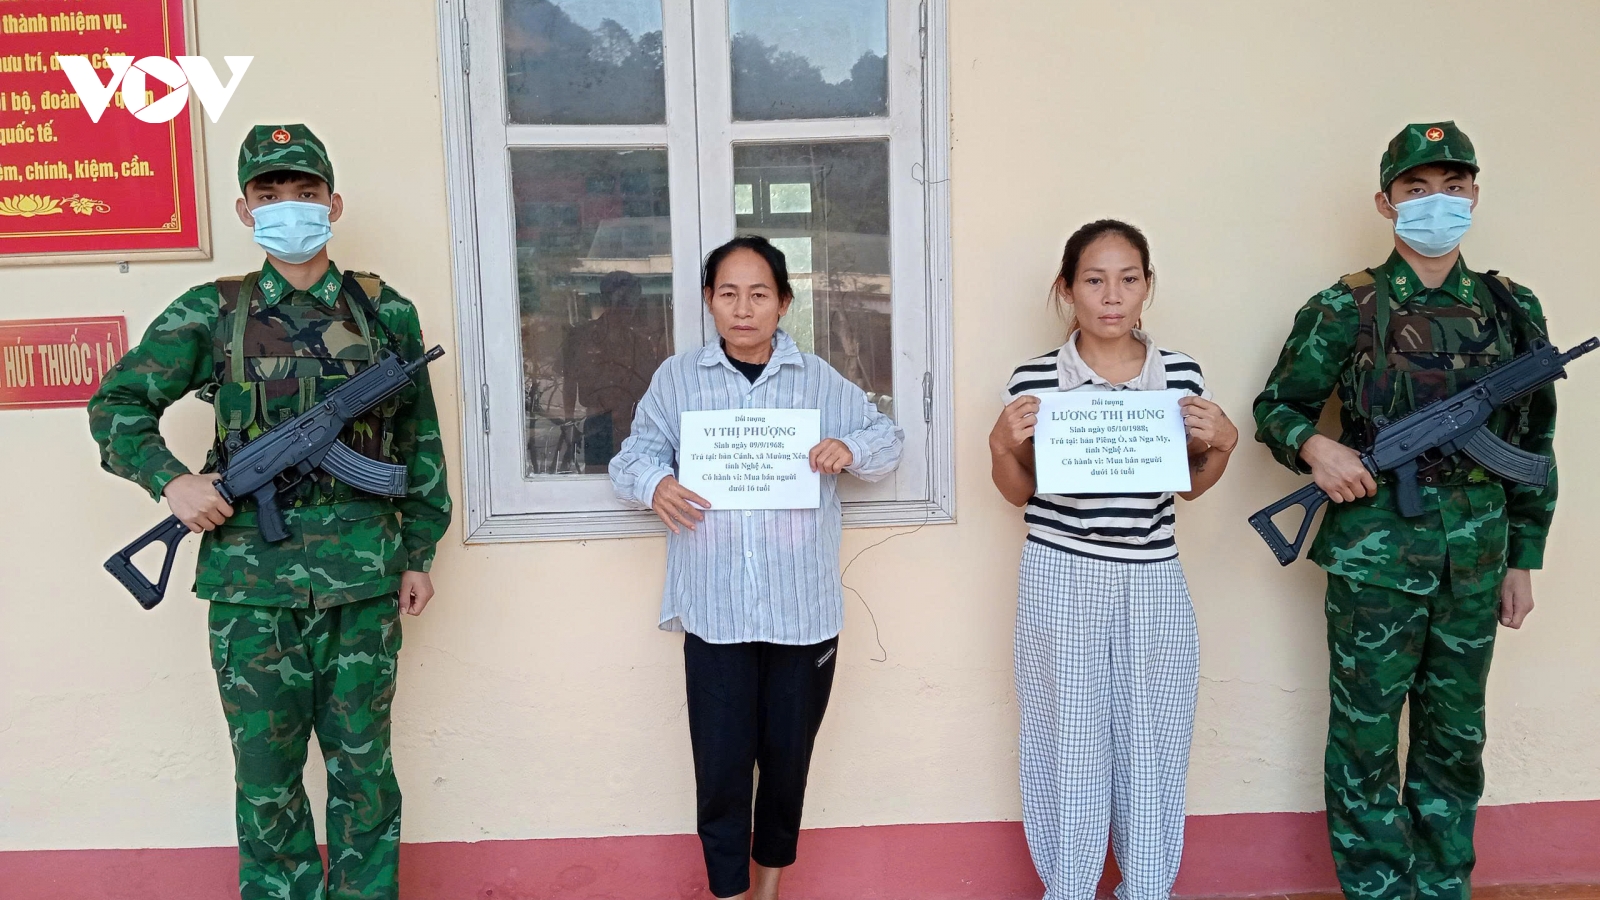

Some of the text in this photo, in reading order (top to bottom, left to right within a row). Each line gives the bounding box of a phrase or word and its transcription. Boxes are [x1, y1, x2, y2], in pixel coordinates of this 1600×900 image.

[2, 11, 127, 35] thành nhiệm vụ.
[0, 55, 22, 72] ưu
[24, 52, 47, 73] trí,
[11, 91, 36, 114] bộ,
[41, 90, 80, 110] đoàn
[37, 120, 58, 142] tế.
[26, 161, 72, 180] chính,
[75, 159, 118, 182] kiệm,
[121, 155, 154, 176] cần.
[3, 337, 35, 387] HÚT
[38, 328, 93, 386] THUỐC
[1052, 409, 1164, 421] LƯƠNG THỊ HƯNG
[704, 426, 796, 438] VI THỊ PHƯỢNG
[1139, 435, 1153, 443] Nga
